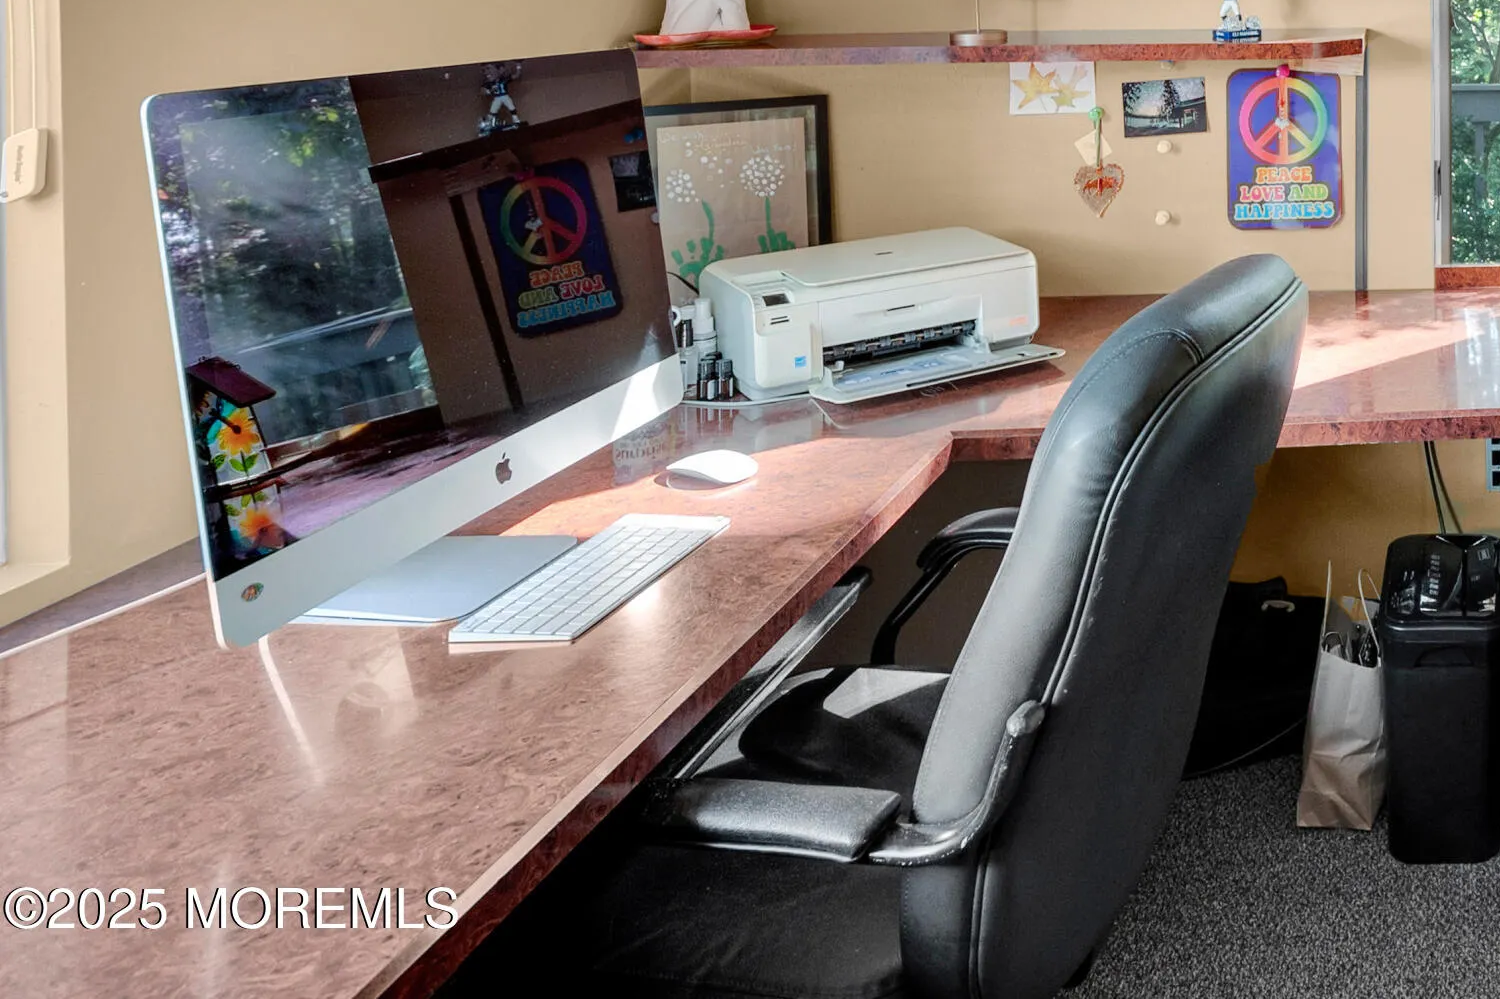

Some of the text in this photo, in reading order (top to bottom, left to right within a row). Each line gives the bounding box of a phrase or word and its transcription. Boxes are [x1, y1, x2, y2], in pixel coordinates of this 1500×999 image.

[1256, 167, 1312, 184] PEACE
[1240, 184, 1329, 202] LOVE AND
[1234, 202, 1335, 221] HAPPINESS
